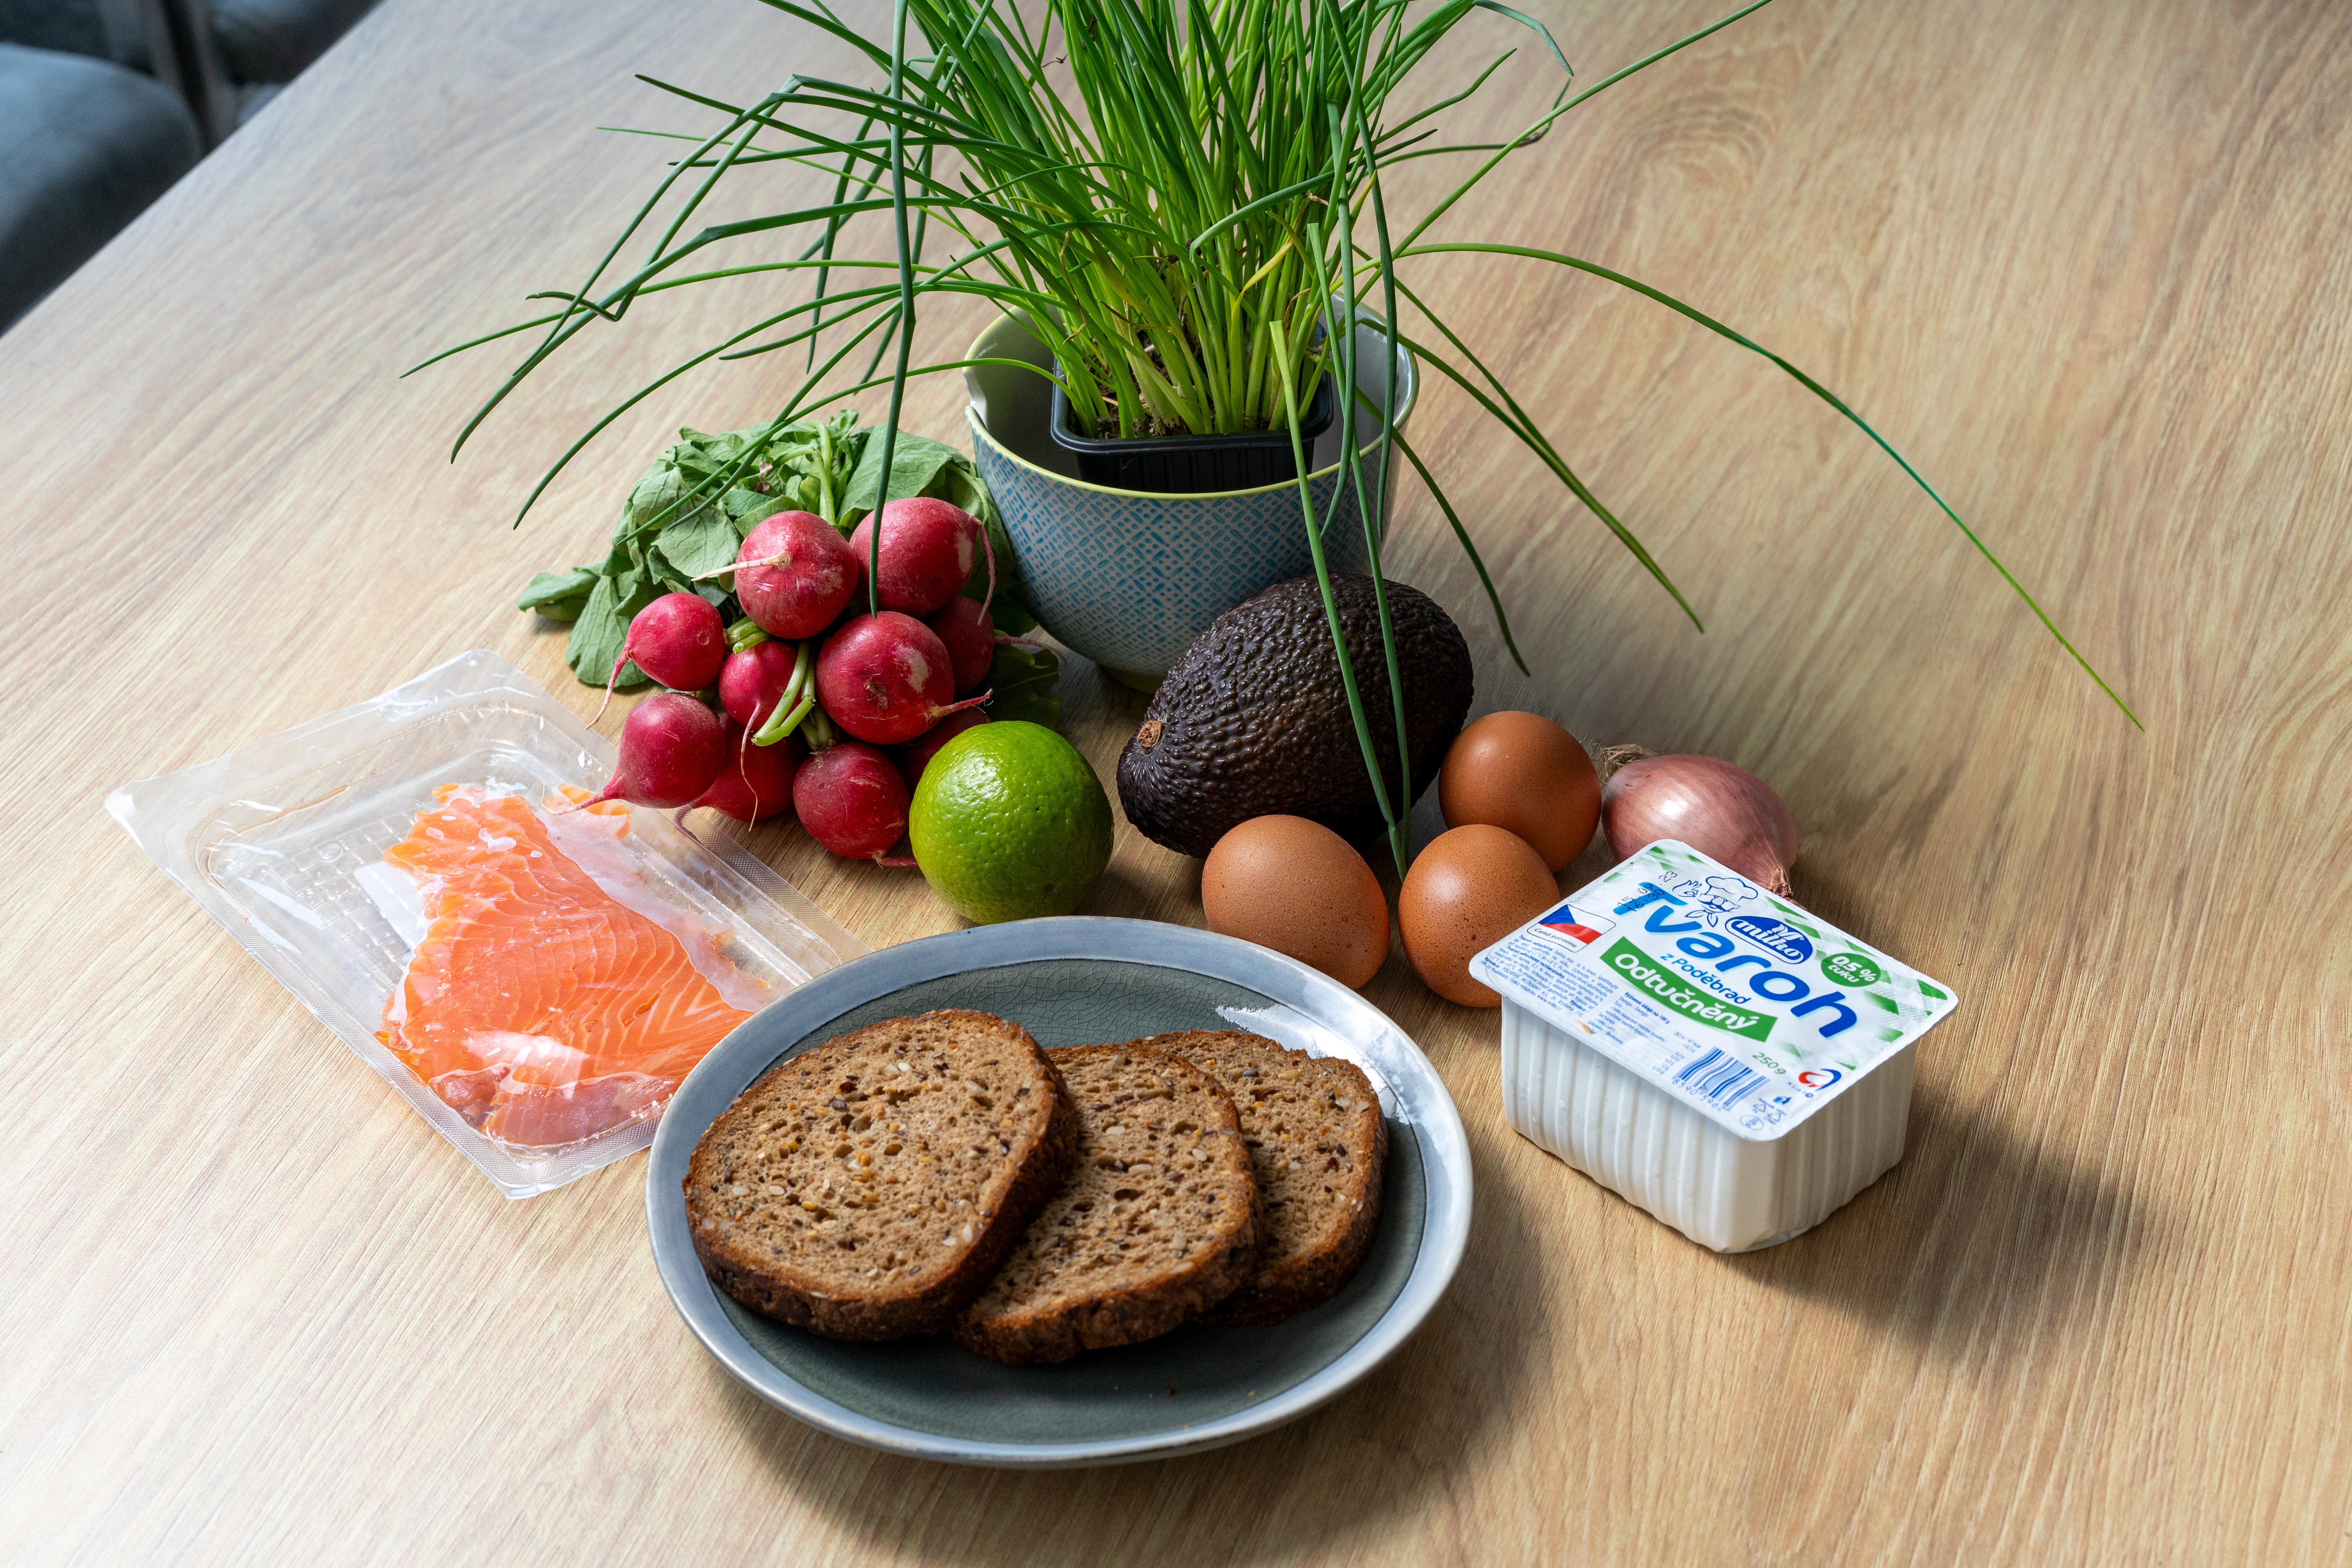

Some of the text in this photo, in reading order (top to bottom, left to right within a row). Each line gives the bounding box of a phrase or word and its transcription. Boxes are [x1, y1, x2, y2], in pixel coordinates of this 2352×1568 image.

[1534, 928, 1577, 948] Česká potravina
[1736, 921, 1799, 956] milko
[1613, 882, 1857, 1037] Tvaroh
[1671, 959, 1751, 1004] Poděbrad
[1828, 965, 1859, 982] tuku
[1858, 969, 1877, 981] %
[1615, 953, 1759, 1030] Odtučněný
[1752, 1052, 1779, 1068] 250
